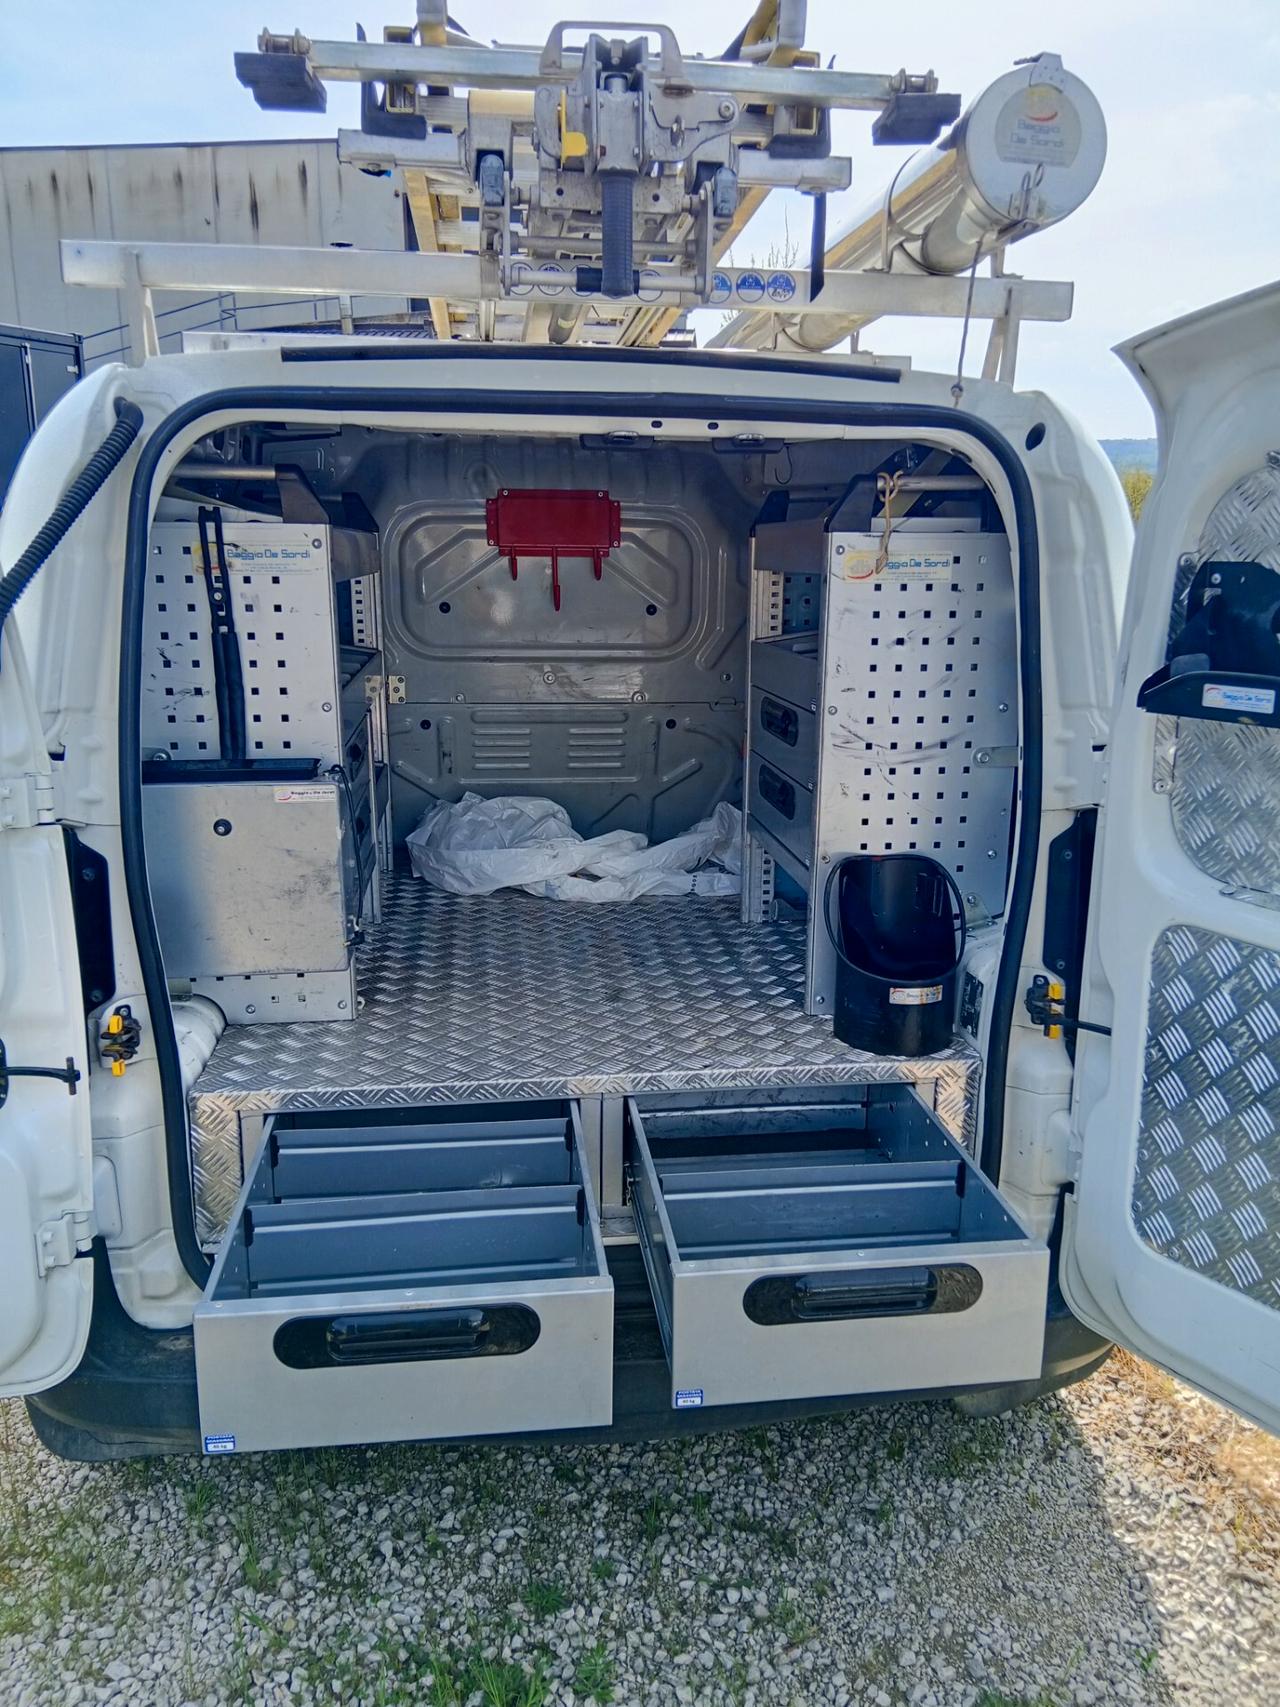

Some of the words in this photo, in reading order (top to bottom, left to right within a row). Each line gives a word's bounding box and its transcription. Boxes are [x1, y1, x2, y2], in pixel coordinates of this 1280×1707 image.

[227, 549, 264, 561] Baggio
[264, 549, 279, 559] De
[281, 548, 310, 559] Sordi
[909, 558, 922, 567] De
[924, 558, 950, 567] Sordi
